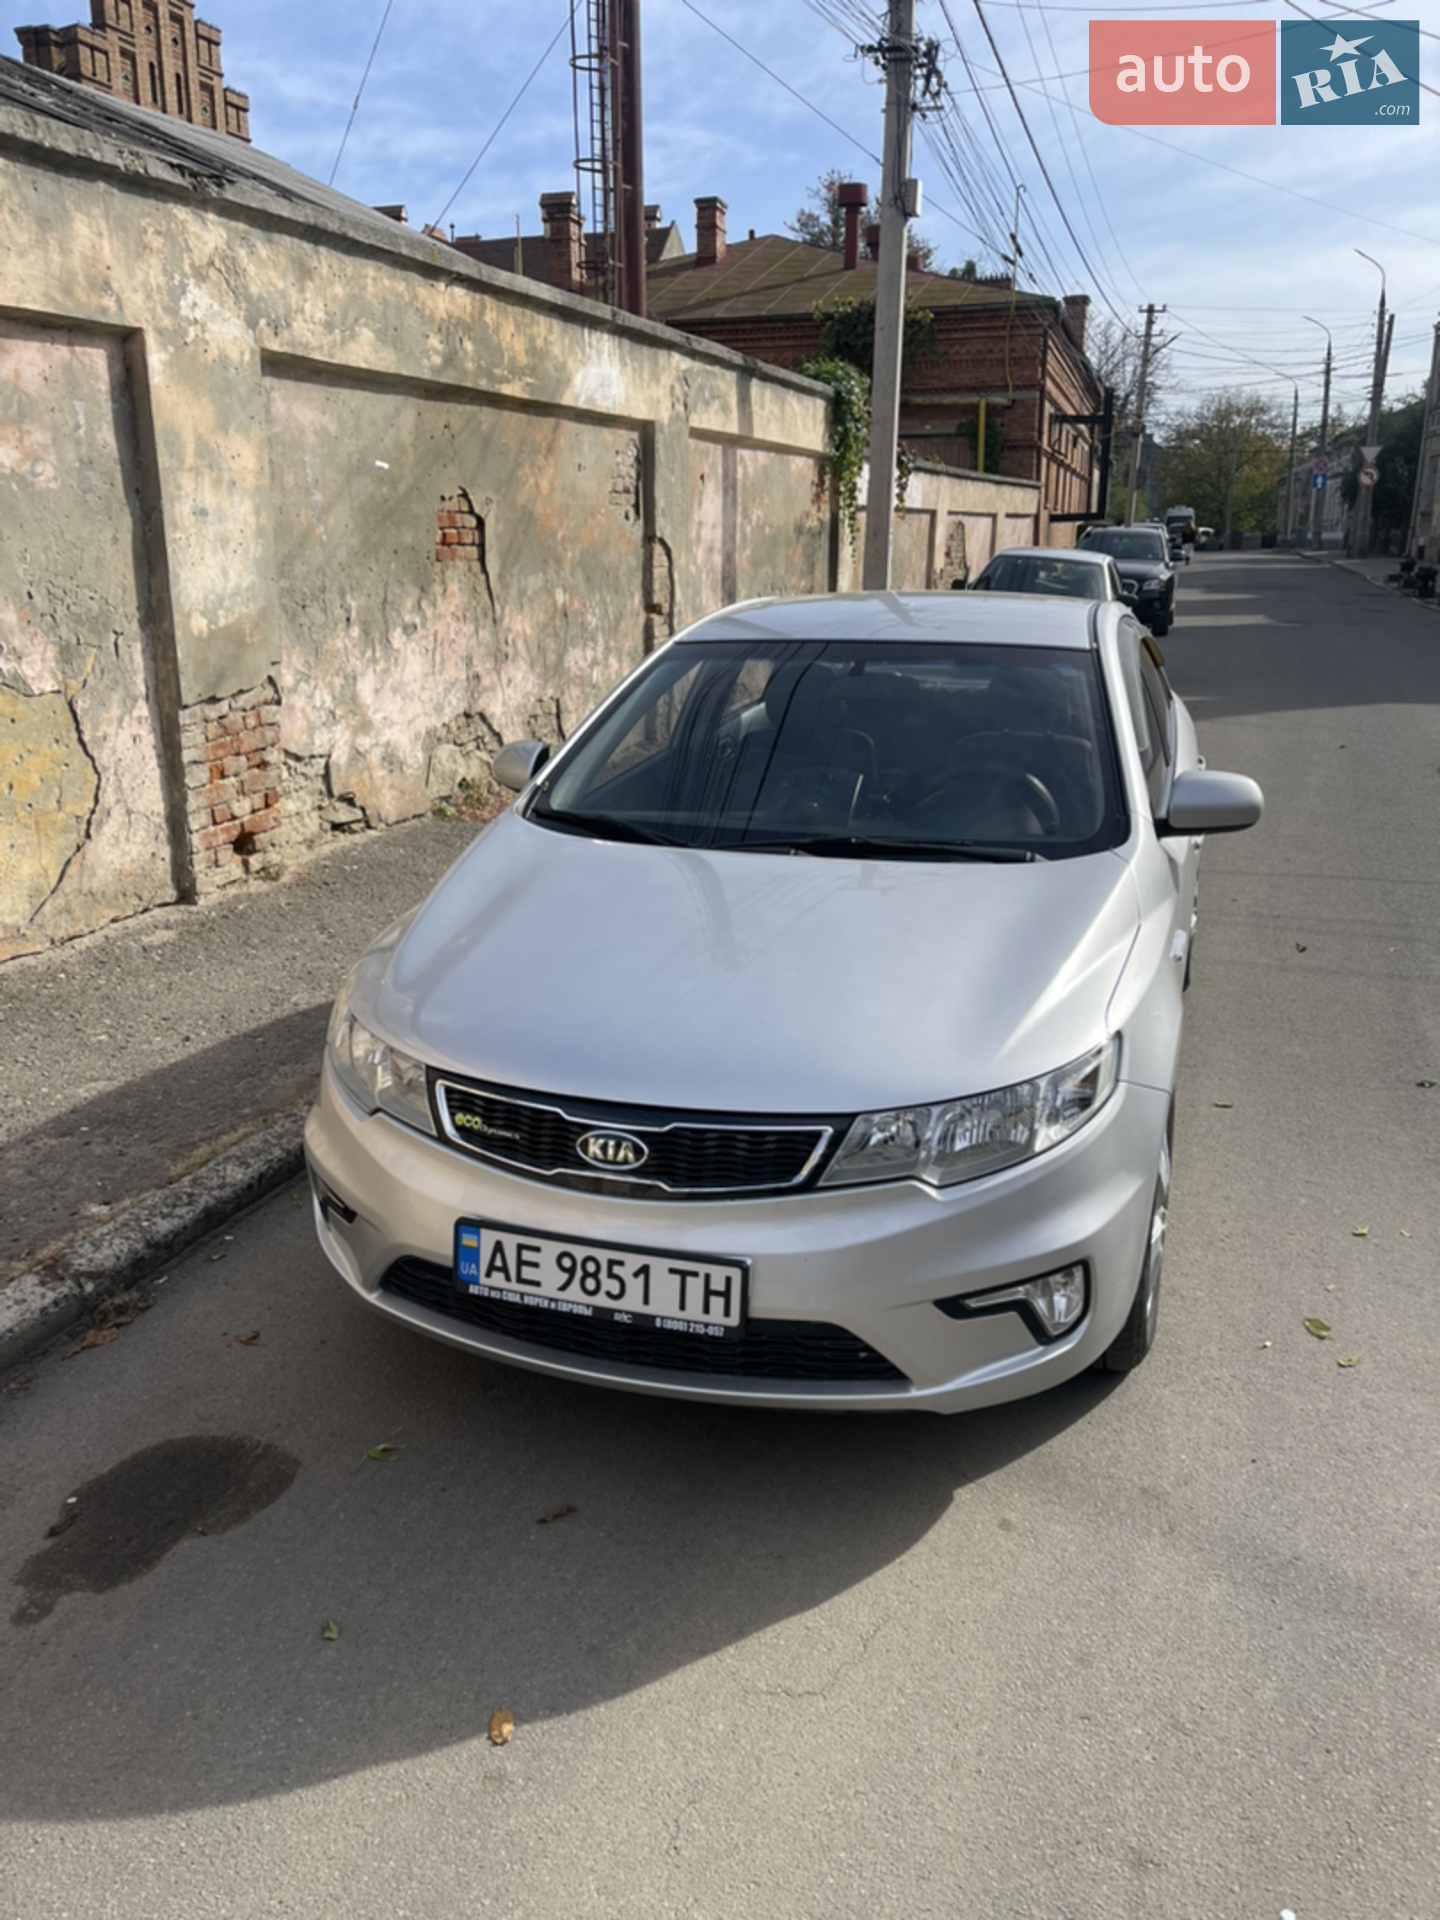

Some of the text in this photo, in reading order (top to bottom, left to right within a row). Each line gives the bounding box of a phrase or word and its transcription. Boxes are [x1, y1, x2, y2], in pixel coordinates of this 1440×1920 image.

[587, 1137, 636, 1164] KIA
[459, 1261, 478, 1276] UA
[484, 1239, 733, 1318] AE 9851 TH
[468, 1284, 490, 1297] АВТО
[557, 1301, 593, 1316] ЕВРОПЫ
